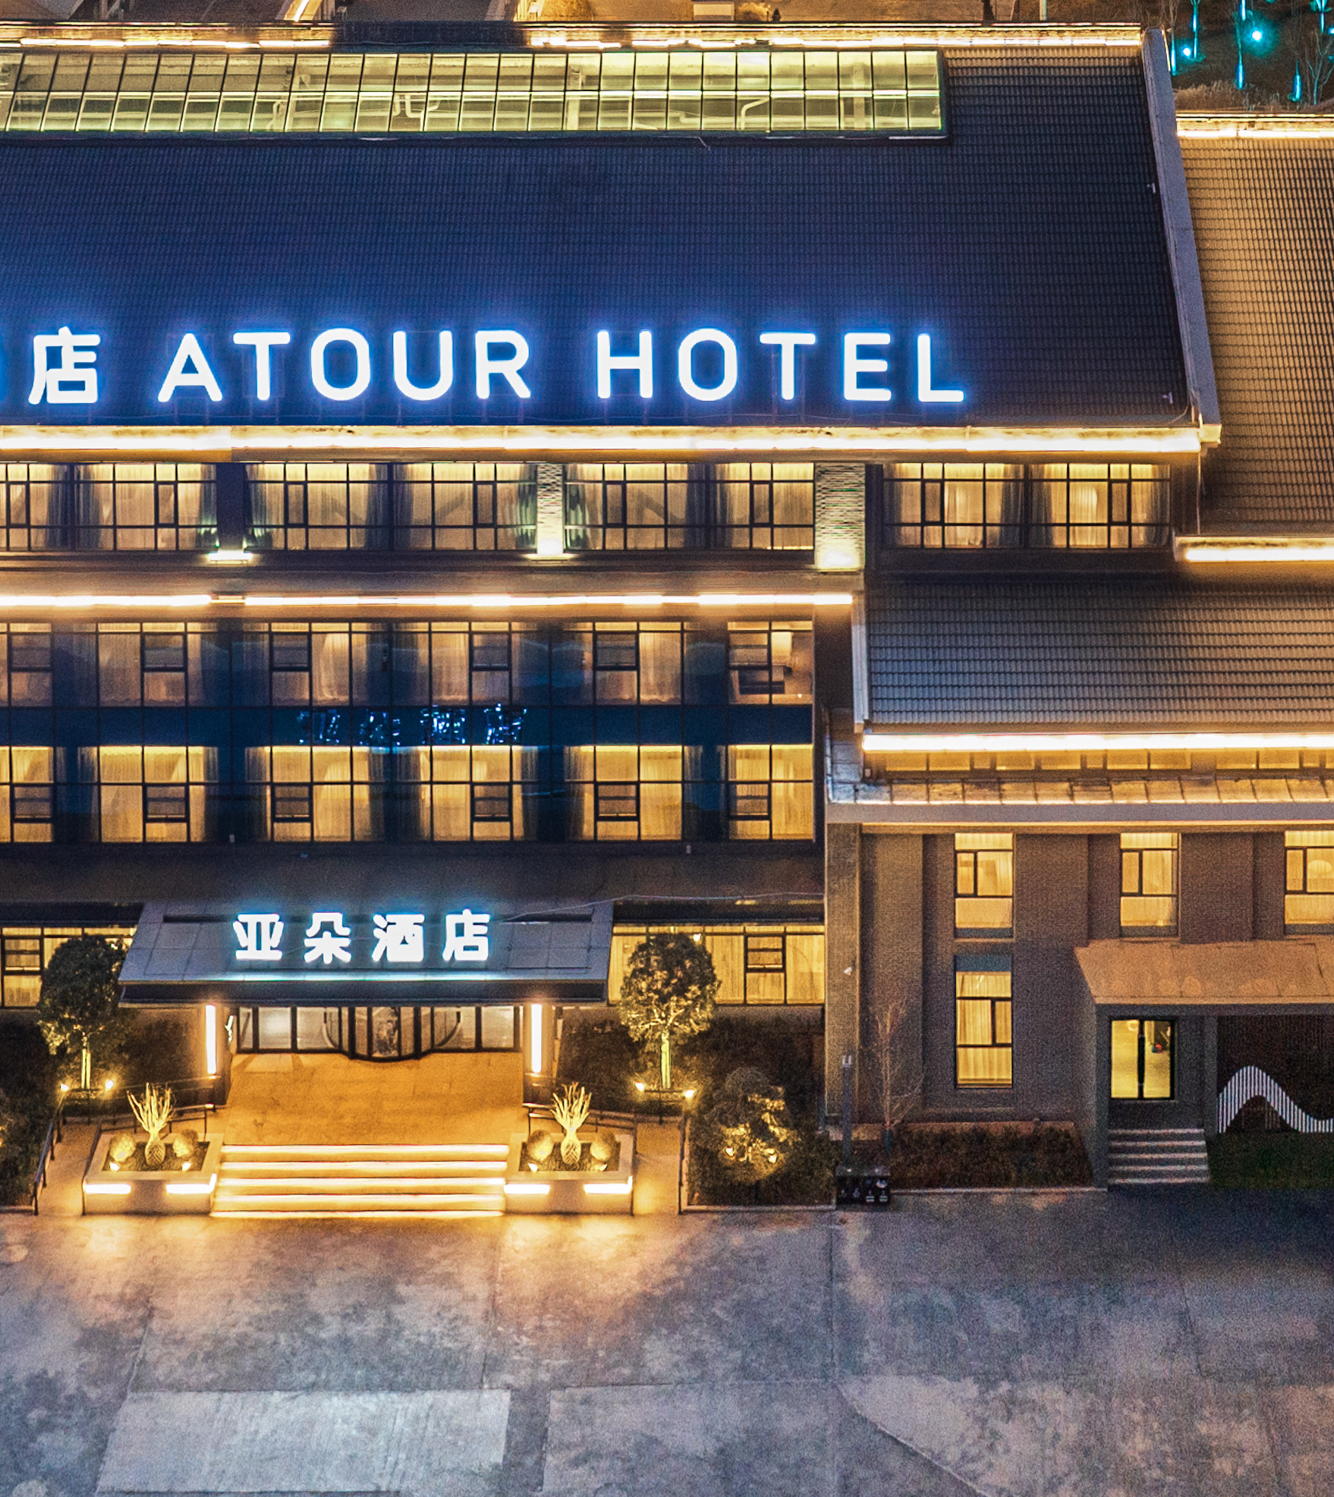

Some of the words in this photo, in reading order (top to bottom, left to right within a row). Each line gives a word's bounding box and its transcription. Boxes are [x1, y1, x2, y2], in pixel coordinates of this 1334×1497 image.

[156, 326, 531, 403] ATOUR
[595, 327, 964, 403] HOTEL
[231, 907, 492, 965] 亚朵酒店
